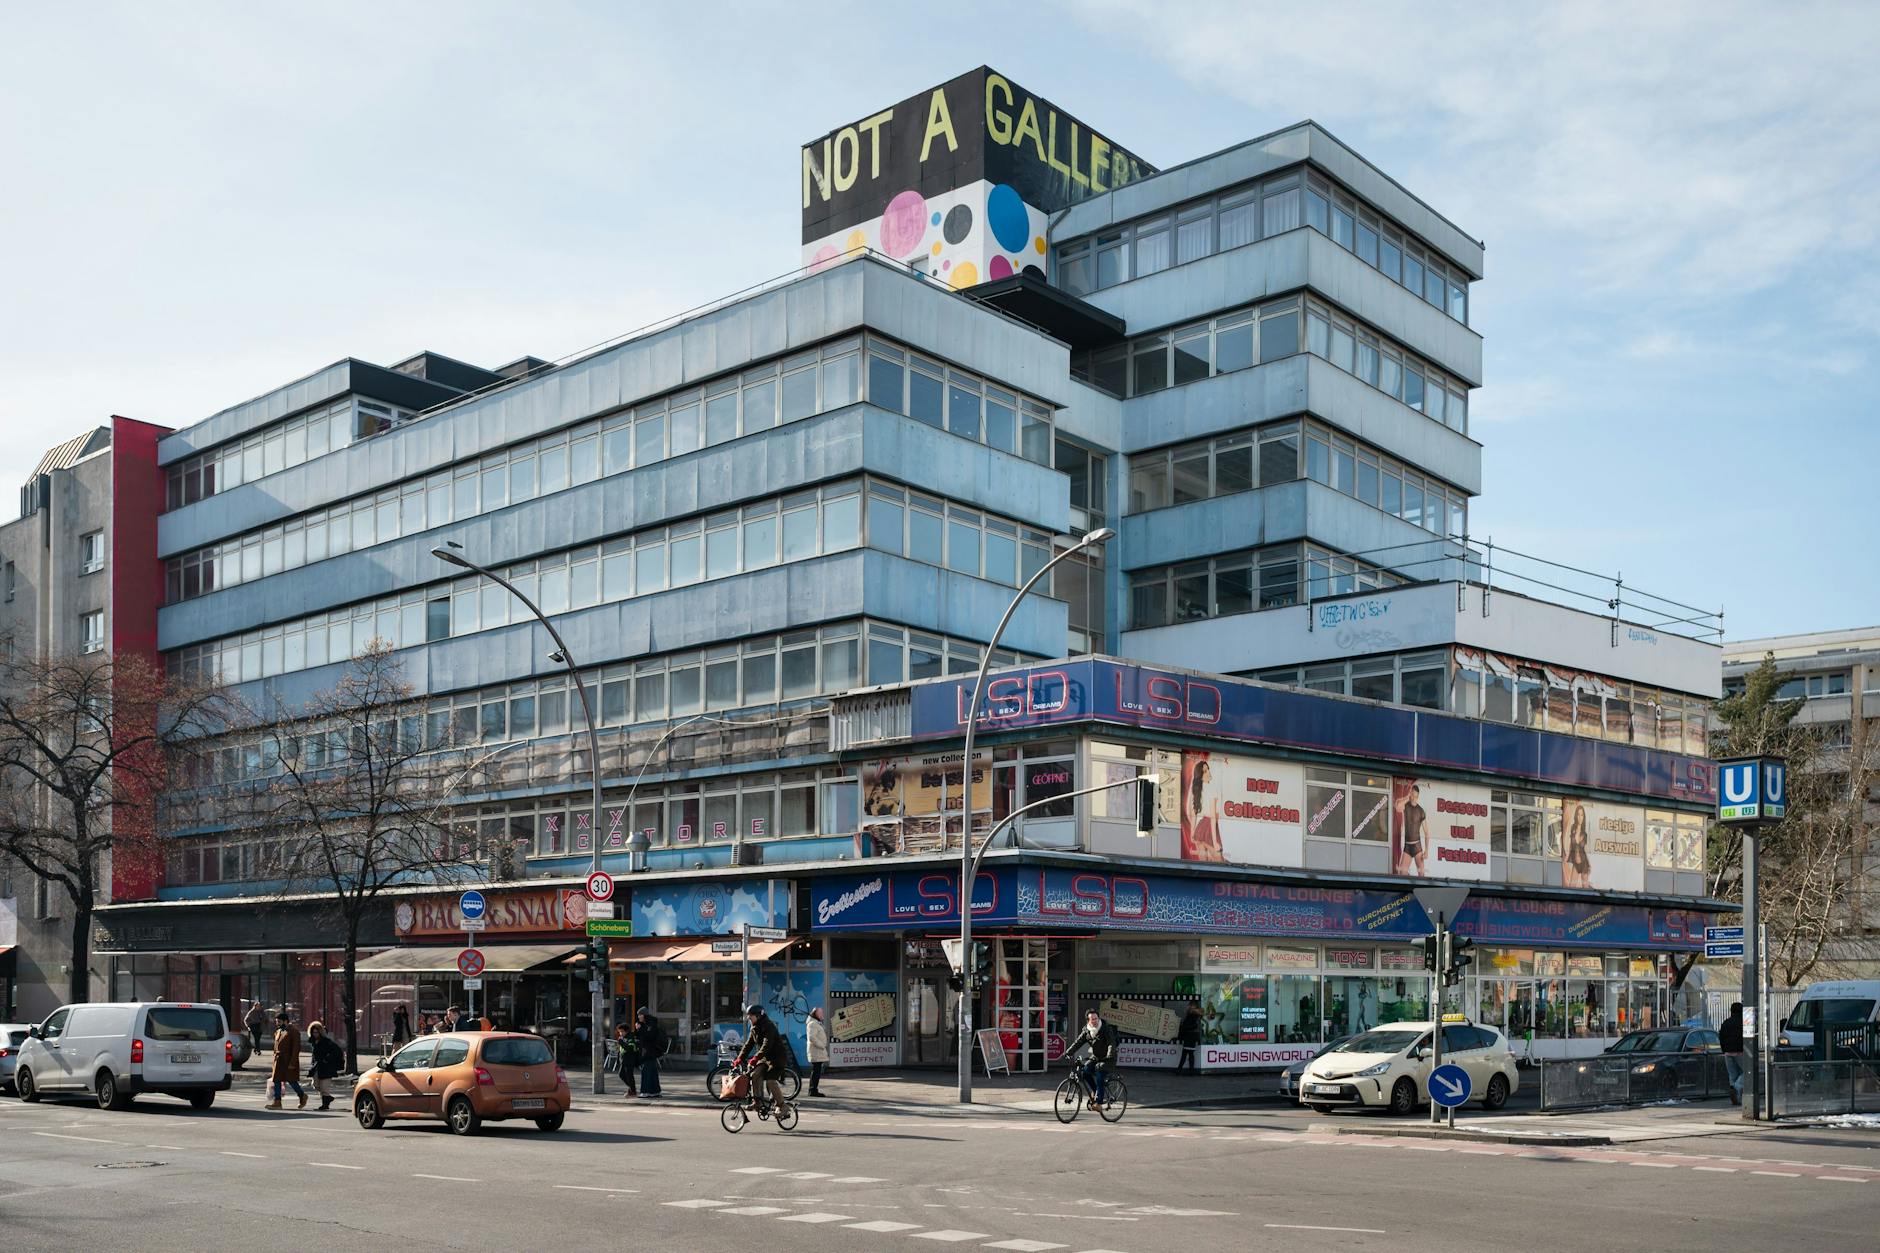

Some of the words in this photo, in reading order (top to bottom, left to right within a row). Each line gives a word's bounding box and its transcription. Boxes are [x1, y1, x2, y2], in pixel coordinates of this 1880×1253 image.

[802, 108, 893, 209] NOT
[919, 87, 959, 163] A
[957, 670, 1069, 725] LSD
[1115, 671, 1222, 725] LSD
[999, 706, 1016, 715] SEX
[1032, 701, 1063, 711] DREAMS
[1122, 701, 1144, 711] LOVE
[1156, 706, 1172, 715] SEX
[1188, 711, 1215, 721] DREAMS
[922, 757, 939, 766] new
[941, 750, 982, 763] Collecon
[1032, 771, 1069, 786] GEÖFFNET
[1246, 777, 1280, 795] new
[1724, 766, 1752, 803] U
[1766, 766, 1782, 803] U
[1223, 799, 1300, 823] Collection
[1307, 789, 1345, 835] BÜCHER
[1436, 797, 1488, 818] Dessous
[1743, 807, 1754, 815] U3
[1450, 824, 1475, 840] und
[1599, 816, 1635, 834] riesige
[1594, 838, 1640, 855] Auswahl
[1437, 846, 1487, 865] Fashion
[593, 879, 608, 893] 30
[1039, 869, 1150, 918] LSD
[1213, 881, 1281, 900] DIGITAL
[1287, 889, 1353, 904] LOUNGE
[818, 877, 882, 924] Eroticstore
[888, 872, 998, 918] LSD
[929, 903, 945, 911] SEX
[1046, 901, 1068, 910] LOVE
[1082, 903, 1098, 911] SEX
[1357, 894, 1411, 925] DURCHGEHEND
[1513, 901, 1565, 916] LOUNGE
[1367, 907, 1404, 930] GEÖFFNET
[1568, 906, 1612, 934] DURCHGEHEND
[1648, 909, 1706, 940] LSD
[590, 923, 629, 933] Schöneberg
[1456, 921, 1565, 938] CRUISINGWORLD
[1576, 918, 1606, 938] GEÖFFNET
[1208, 950, 1255, 961] FASHION
[1271, 952, 1314, 962] MAGAZINE
[1331, 951, 1368, 965] TOYS
[1381, 954, 1424, 965] DESSOUS
[1571, 958, 1600, 969] SPIELE
[846, 1003, 867, 1018] LSD
[1102, 1011, 1123, 1021] KINO
[1120, 1001, 1146, 1015] LSD
[835, 1022, 853, 1034] KINO
[1048, 1038, 1060, 1046] 24
[833, 1046, 894, 1055] DURCHGEHEND
[843, 1054, 885, 1064] GEÖFFNET
[1118, 1055, 1165, 1064] EÖFFNET
